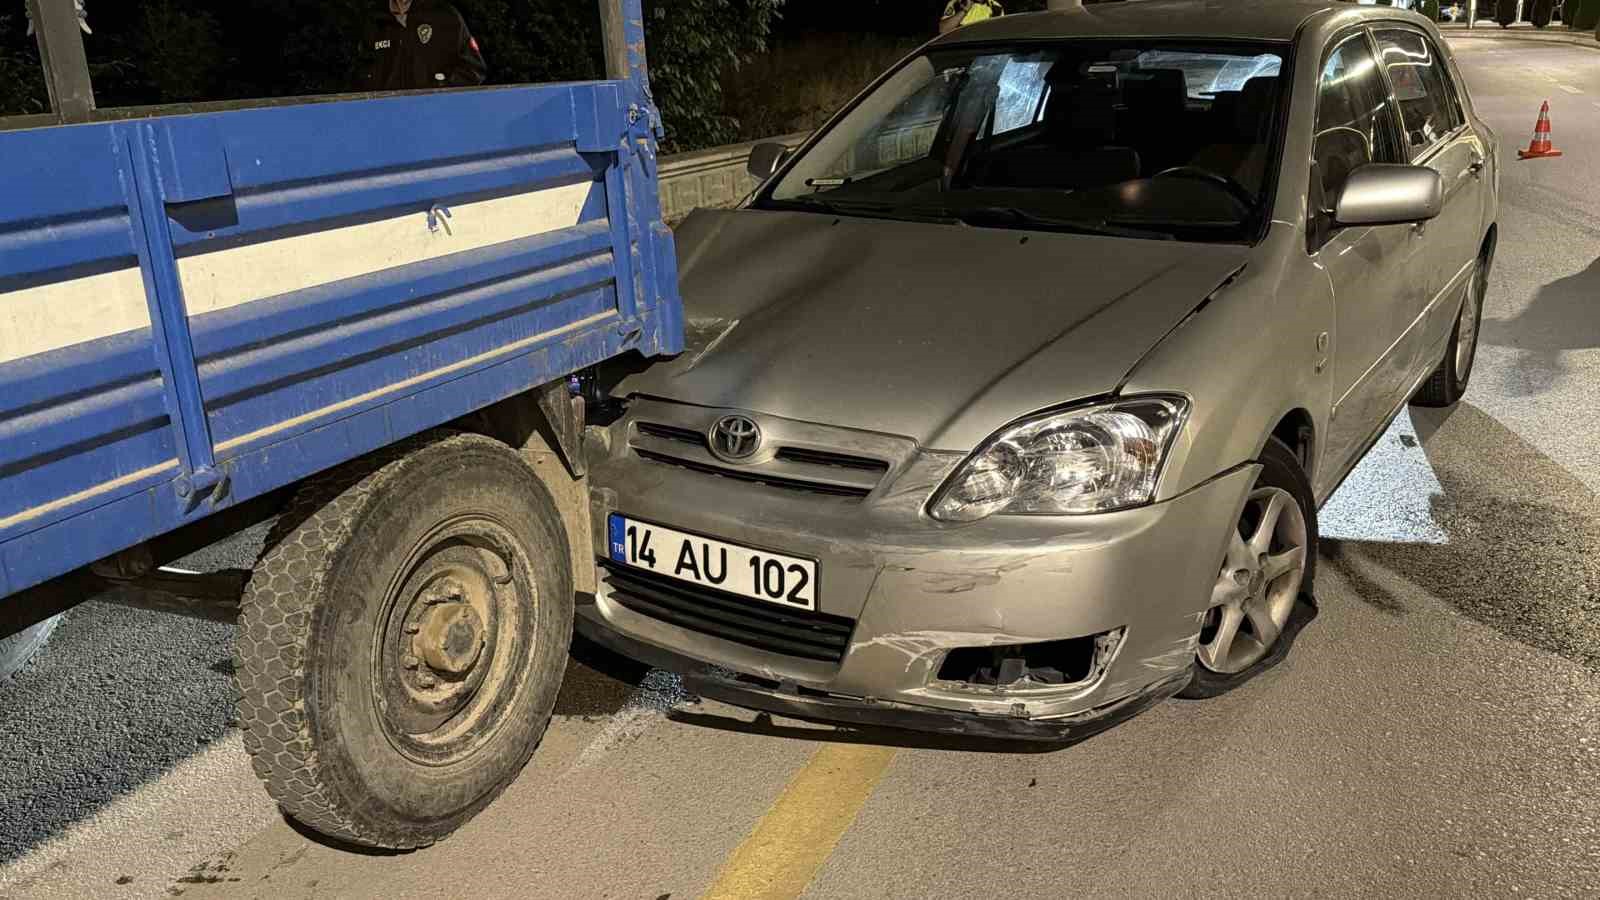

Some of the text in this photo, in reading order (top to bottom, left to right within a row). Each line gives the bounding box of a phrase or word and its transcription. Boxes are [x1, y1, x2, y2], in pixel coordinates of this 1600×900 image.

[612, 541, 625, 554] TR
[627, 525, 810, 606] 14 AU 102
